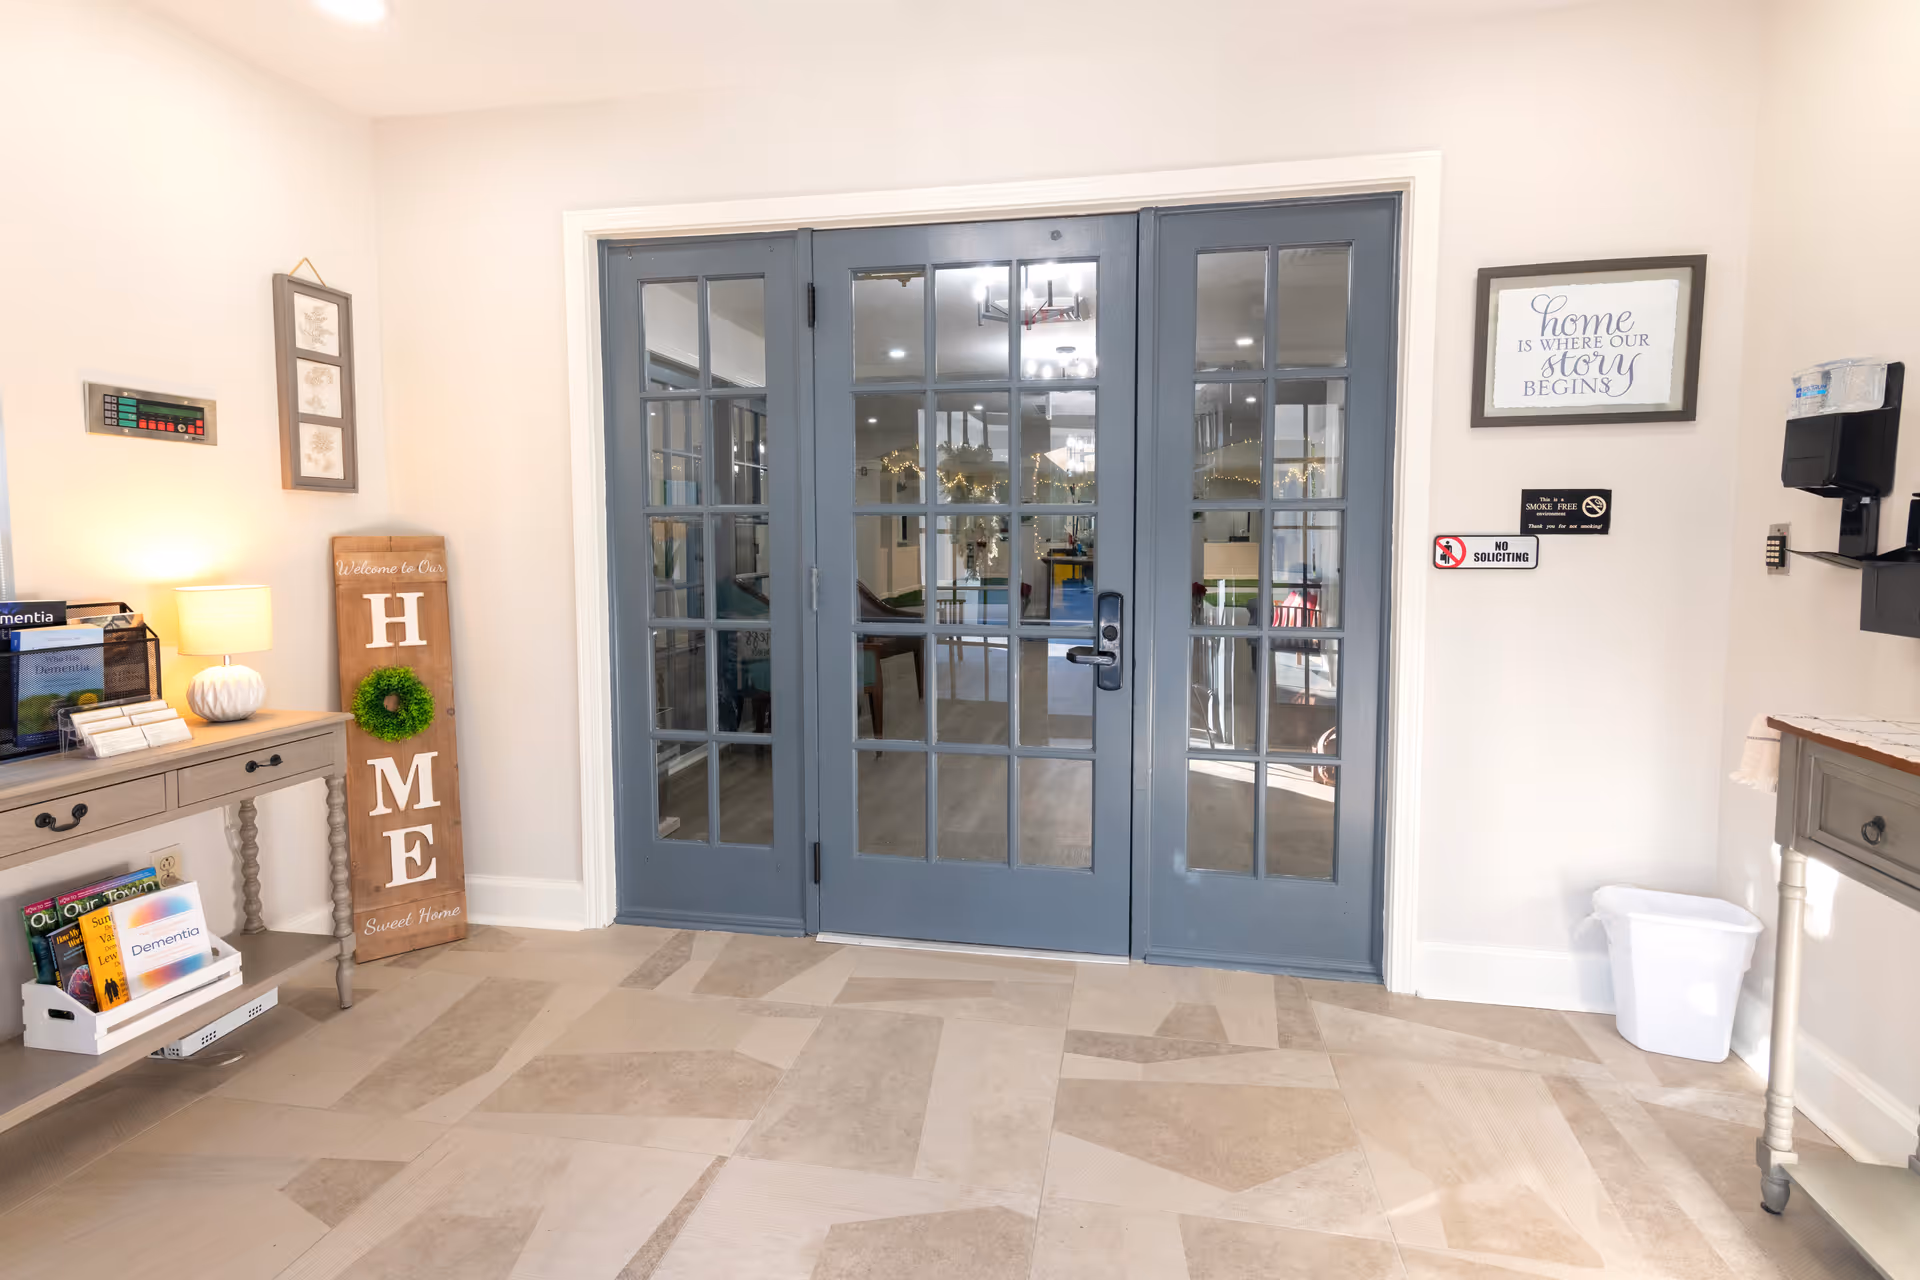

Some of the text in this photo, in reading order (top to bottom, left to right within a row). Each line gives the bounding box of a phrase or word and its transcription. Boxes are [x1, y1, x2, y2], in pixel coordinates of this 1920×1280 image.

[1531, 294, 1635, 337] home
[1517, 333, 1650, 352] IS WHERE OUR
[1541, 351, 1642, 398] story
[1523, 377, 1612, 397] BEGINS
[1494, 541, 1509, 551] NO
[1473, 552, 1530, 563] SOLICITING
[336, 559, 445, 576] Welcome to Our
[0, 611, 54, 625] mentia
[34, 664, 90, 674] Dementia
[64, 898, 98, 918] Our
[102, 880, 155, 903] Town
[30, 912, 57, 928] Ou
[364, 905, 461, 936] Sweet Home
[99, 933, 116, 944] Vas
[131, 927, 200, 956] Dementia
[98, 952, 118, 966] Lew
